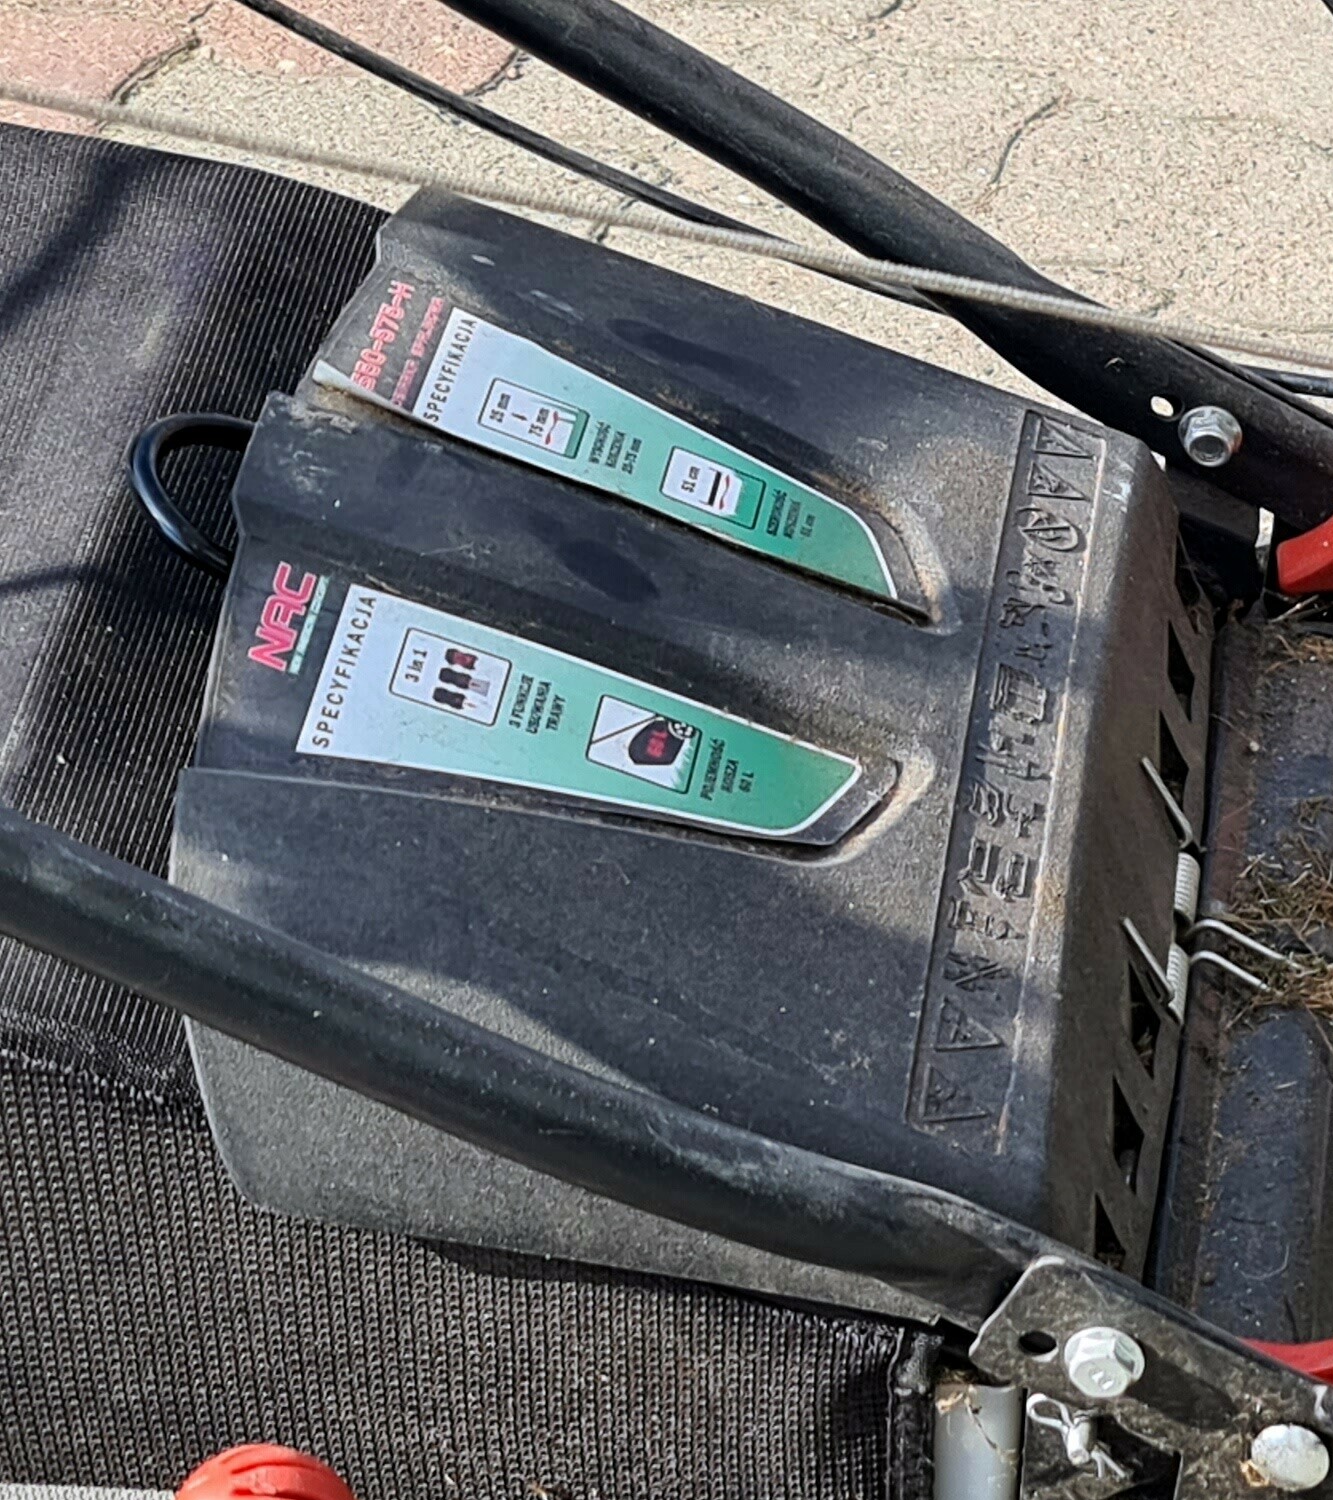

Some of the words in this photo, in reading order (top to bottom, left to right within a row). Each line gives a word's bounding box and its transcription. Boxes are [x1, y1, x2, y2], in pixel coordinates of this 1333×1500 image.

[423, 319, 477, 422] SPECYFIKACJA
[248, 560, 317, 672] NAC
[405, 673, 419, 683] 3
[413, 649, 427, 659] 1
[312, 597, 377, 749] SPECYFIKACJA
